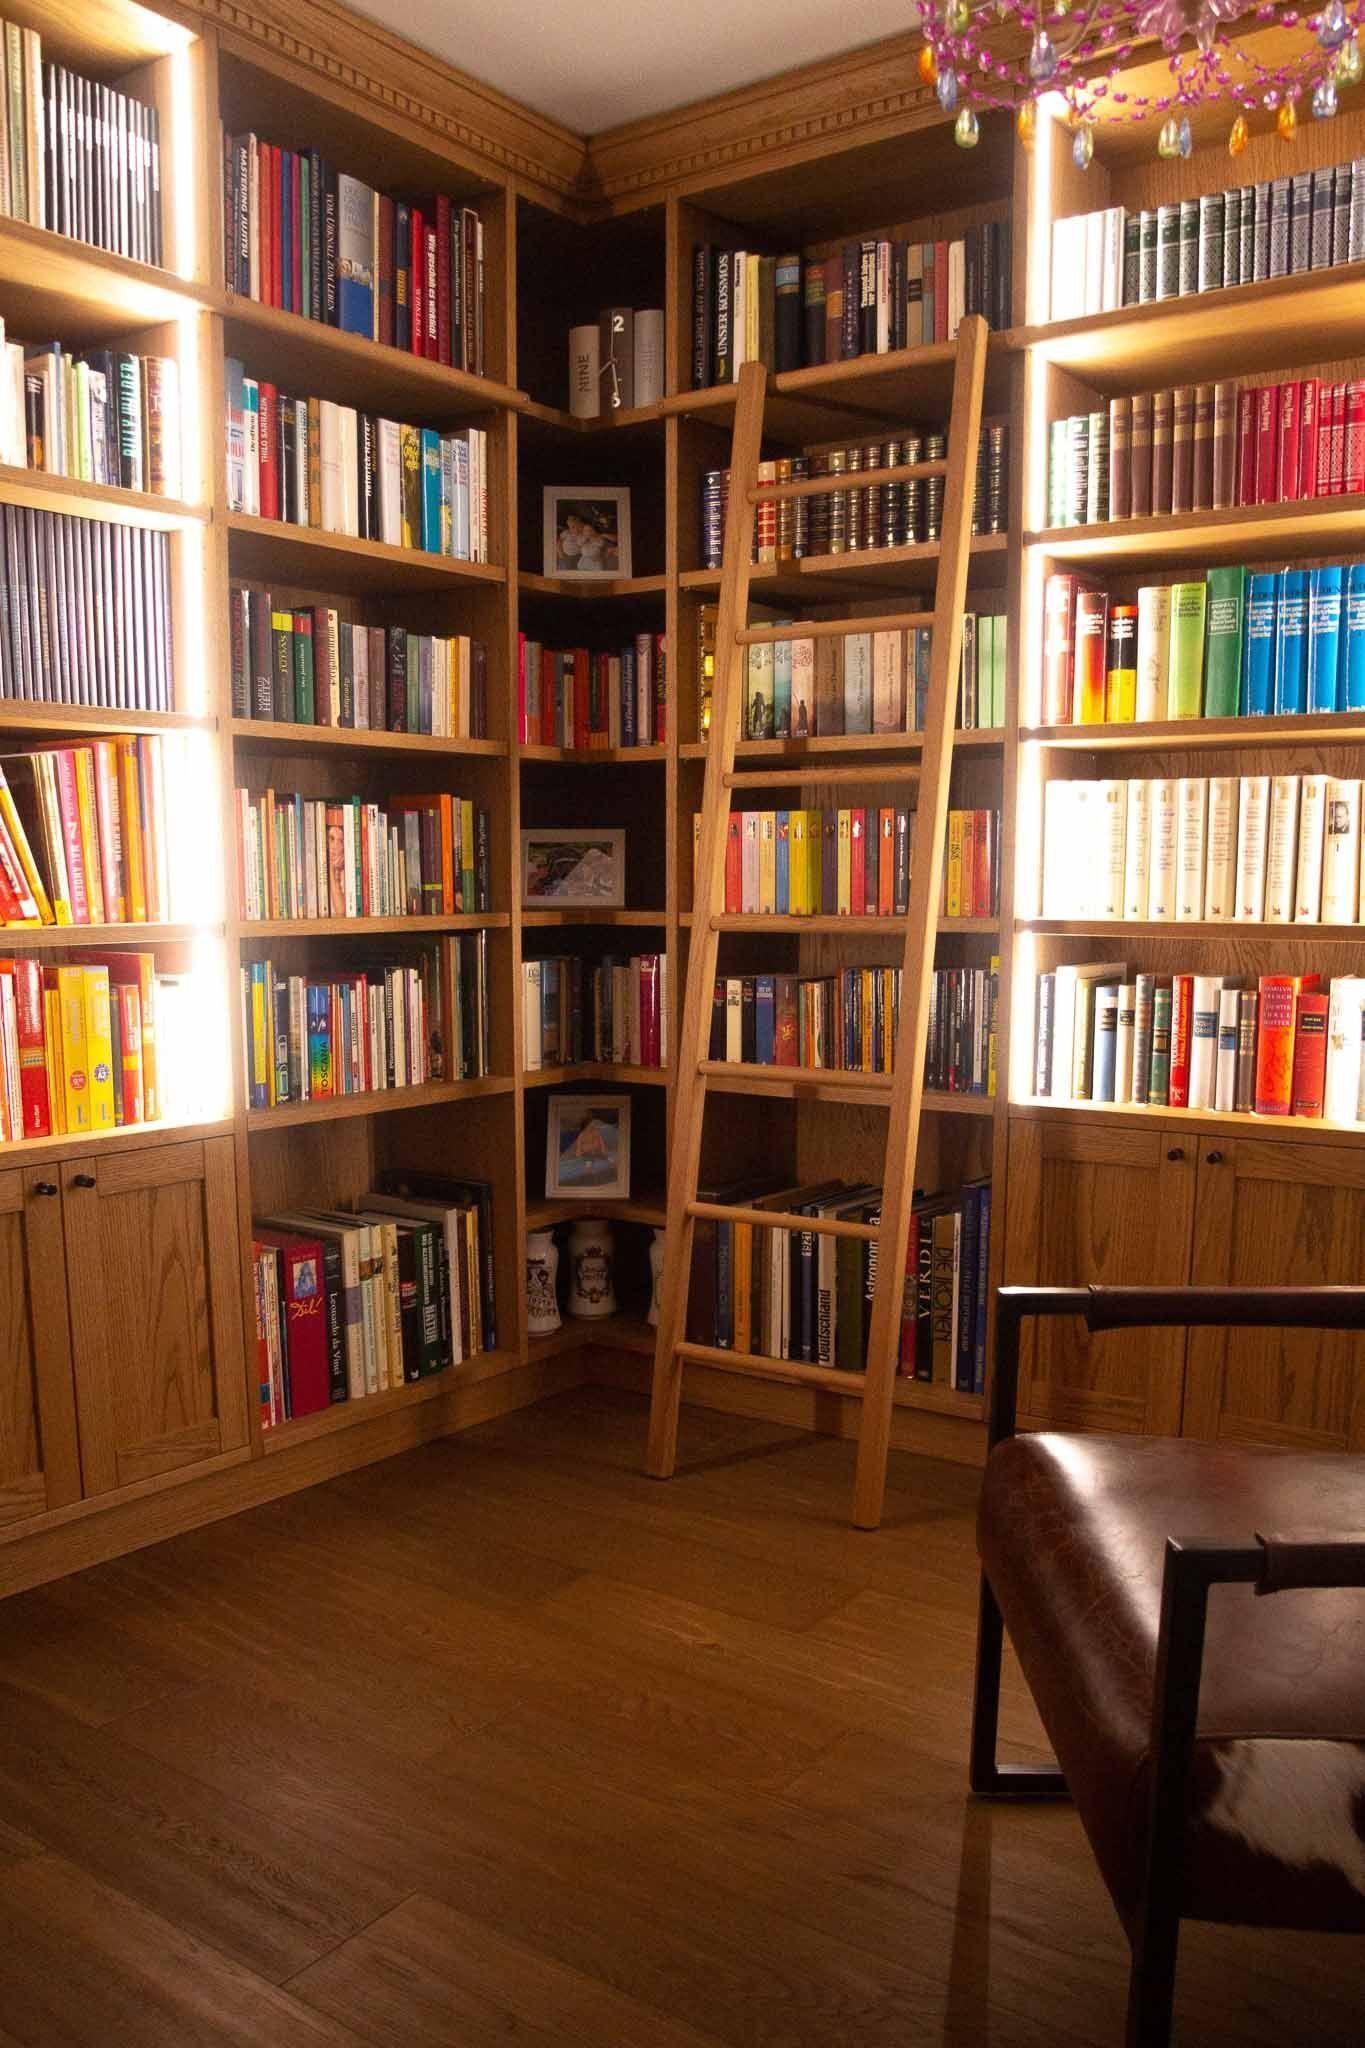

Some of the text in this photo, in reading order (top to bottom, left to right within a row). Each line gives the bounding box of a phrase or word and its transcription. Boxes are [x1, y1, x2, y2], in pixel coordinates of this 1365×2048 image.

[240, 147, 249, 259] MASTERING JUJITSU
[325, 193, 336, 215] VOM
[717, 255, 729, 356] UNSER KOSMOS
[120, 362, 137, 457] BILLY WILDER
[260, 397, 269, 463] THILO SARRAZIN
[279, 634, 288, 673] JUDAS
[256, 676, 265, 711] MARKUS
[262, 676, 271, 711] HEITZ
[70, 844, 80, 864] MAL
[71, 867, 83, 901] ANDERS
[319, 1040, 329, 1095] TOSCANA
[918, 1238, 932, 1319] VERDI
[329, 1291, 339, 1336] Leonardo
[423, 1305, 438, 1345] NATUR
[816, 1289, 832, 1362] Deutschland
[332, 1350, 343, 1376] Vinci
